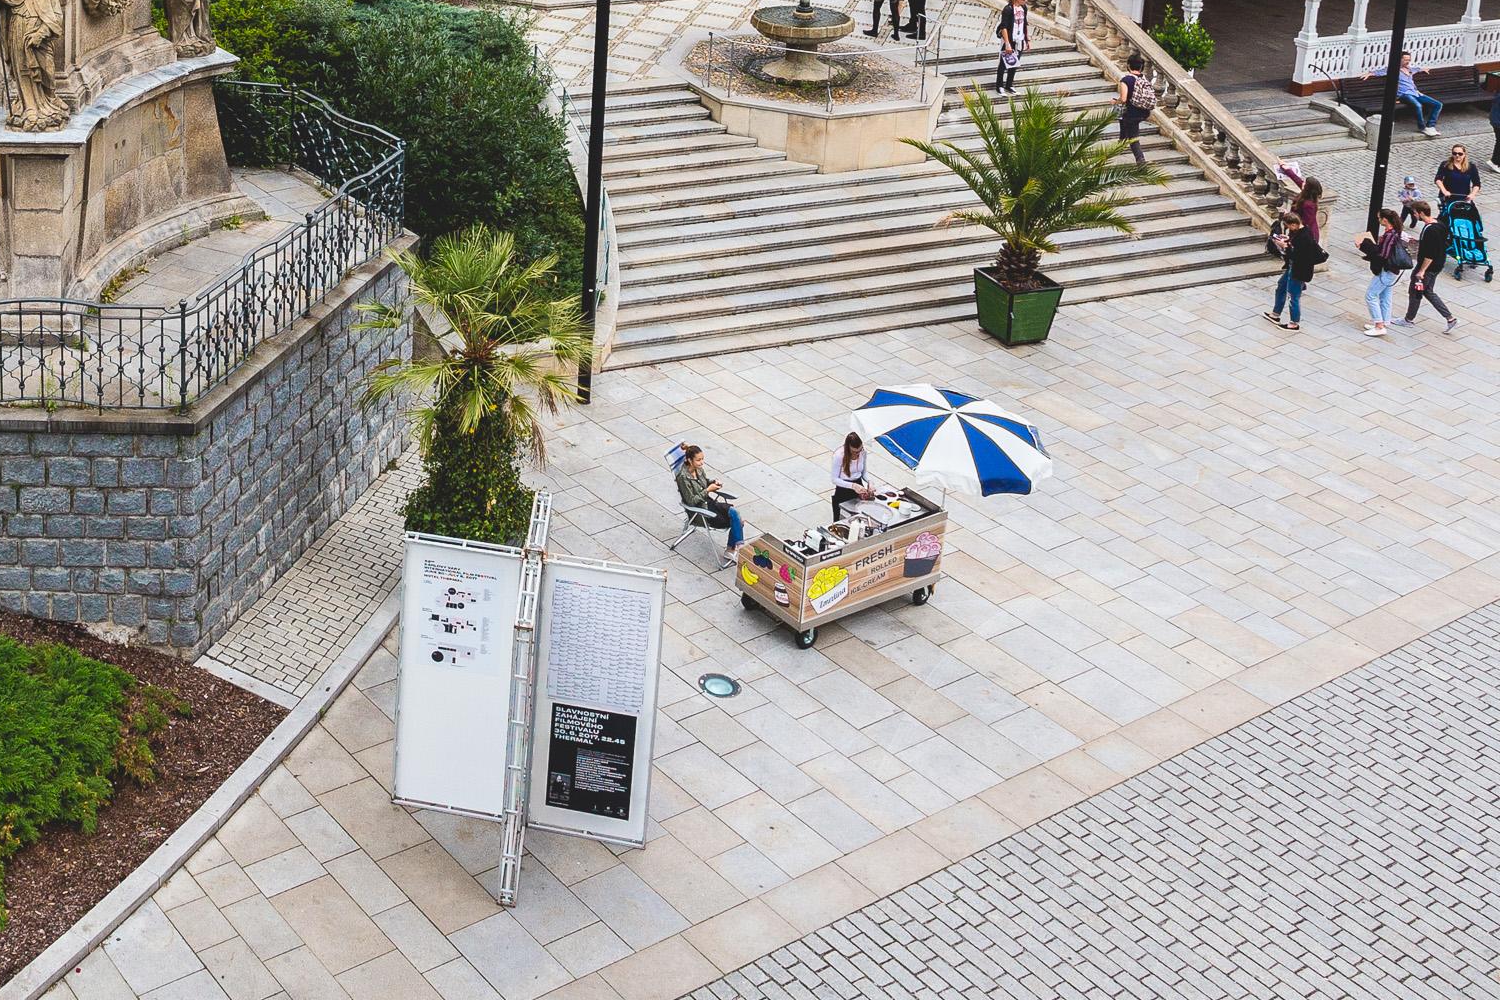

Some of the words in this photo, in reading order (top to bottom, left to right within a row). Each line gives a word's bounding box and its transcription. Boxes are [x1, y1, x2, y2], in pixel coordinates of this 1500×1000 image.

[855, 544, 893, 571] FRESH
[870, 556, 898, 575] ROLLED
[850, 571, 887, 595] ICE-CREAM
[555, 706, 610, 720] SLAVNOSTNÍ
[555, 711, 598, 724] ZAHÁJENÍ
[554, 722, 600, 735] FESTIVALU
[555, 717, 604, 730] FILMOVÉHO
[554, 733, 594, 745] THERMAL
[579, 731, 600, 741] 2017,
[601, 736, 626, 745] 22.45
